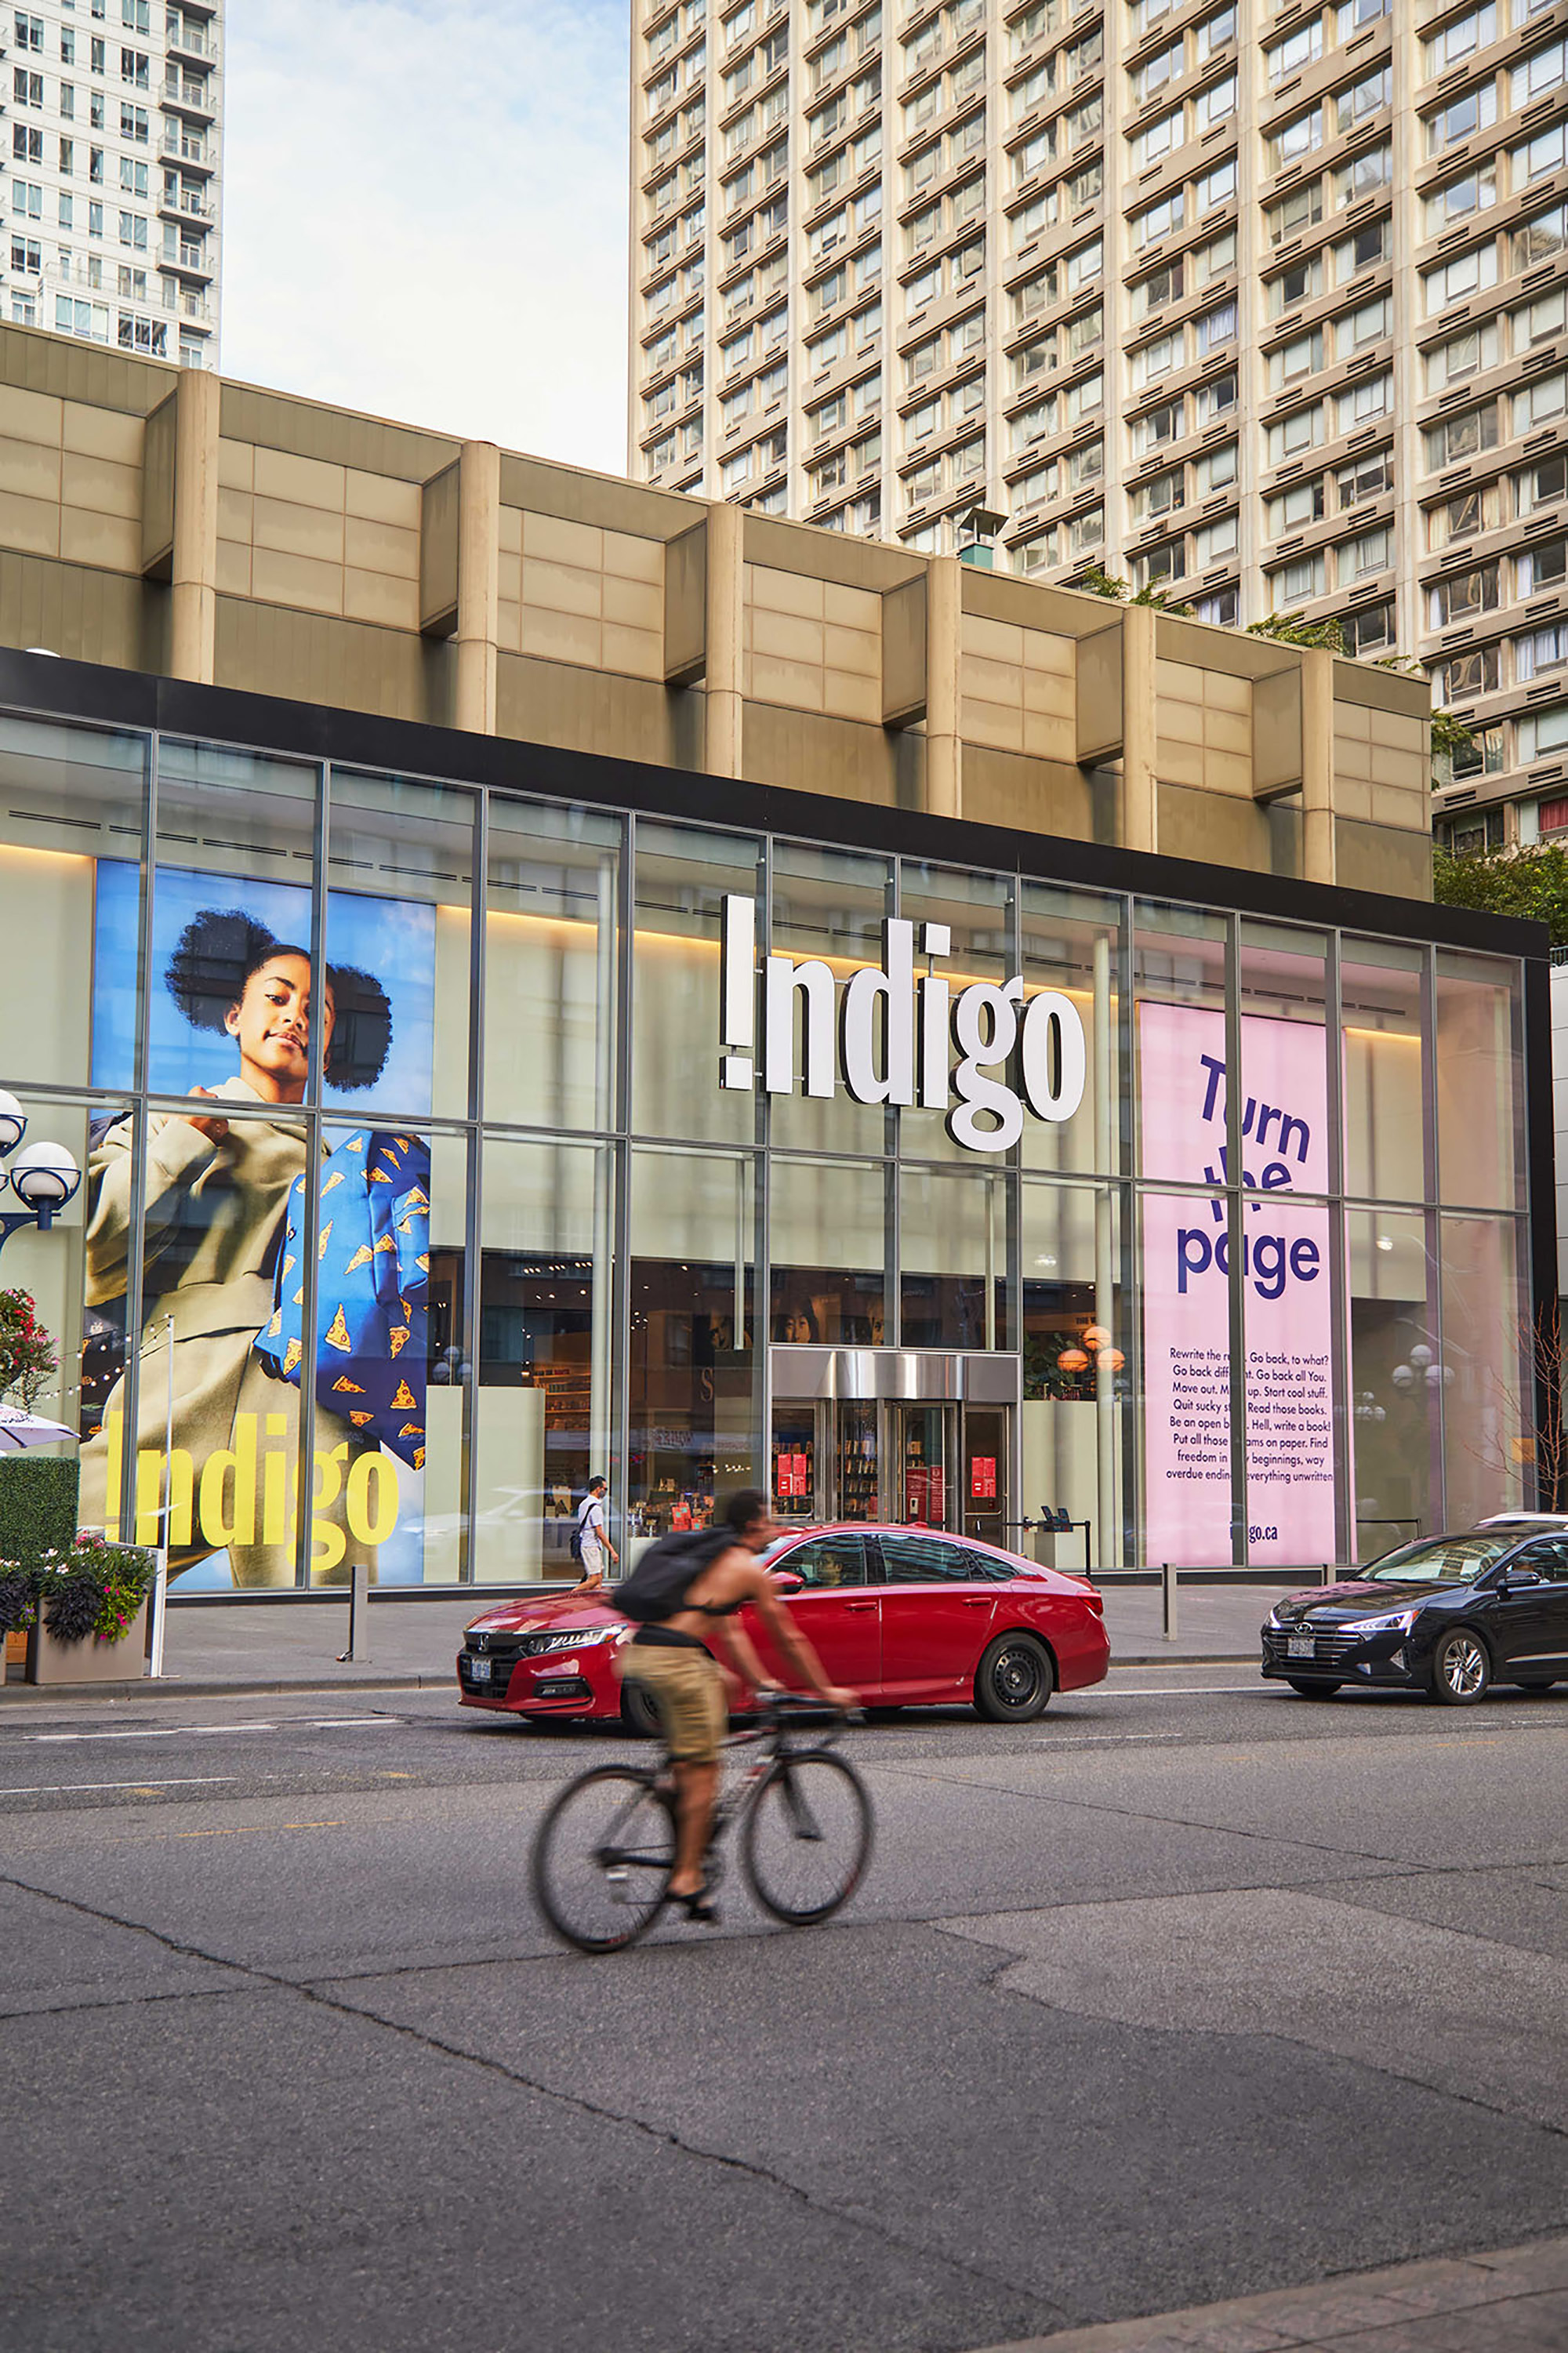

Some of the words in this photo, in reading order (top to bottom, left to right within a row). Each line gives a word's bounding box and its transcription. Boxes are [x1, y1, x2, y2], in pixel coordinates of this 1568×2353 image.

[1200, 1054, 1310, 1163] Turn
[1178, 1228, 1319, 1300] page
[1170, 1348, 1204, 1360] Rewrite
[1207, 1349, 1221, 1360] the
[1250, 1352, 1264, 1363] Go
[1266, 1352, 1290, 1364] back,
[1292, 1356, 1301, 1364] to
[1303, 1354, 1329, 1365] what?
[1173, 1364, 1188, 1375] Go
[1190, 1364, 1212, 1377] back
[1256, 1369, 1270, 1380] Go
[1272, 1369, 1294, 1381] back
[1296, 1371, 1305, 1381] all
[1308, 1371, 1327, 1382] You.
[1172, 1382, 1198, 1393] Move
[1200, 1385, 1218, 1394] out.
[1248, 1389, 1261, 1399] up.
[1264, 1386, 1285, 1397] Start
[1287, 1387, 1305, 1397] cool
[1308, 1387, 1327, 1398] stuff.
[1174, 1399, 1193, 1410] Quit
[1196, 1400, 1221, 1414] sucky
[1248, 1402, 1270, 1413] Read
[1273, 1403, 1296, 1414] those
[1298, 1403, 1327, 1415] books.
[1170, 1416, 1181, 1427] Be
[1198, 1420, 1221, 1431] open
[1252, 1418, 1272, 1431] Hell,
[1274, 1420, 1296, 1431] write
[1307, 1420, 1330, 1432] book!
[1174, 1433, 1188, 1444] Put
[1190, 1433, 1201, 1444] all
[1203, 1433, 1228, 1446] those
[1279, 1440, 1308, 1451] paper.
[1310, 1436, 1328, 1448] Find
[1178, 1449, 1217, 1462] freedom
[1219, 1452, 1228, 1462] in
[1252, 1452, 1304, 1467] beginnings,
[1305, 1458, 1325, 1467] way
[1166, 1467, 1203, 1479] overdue
